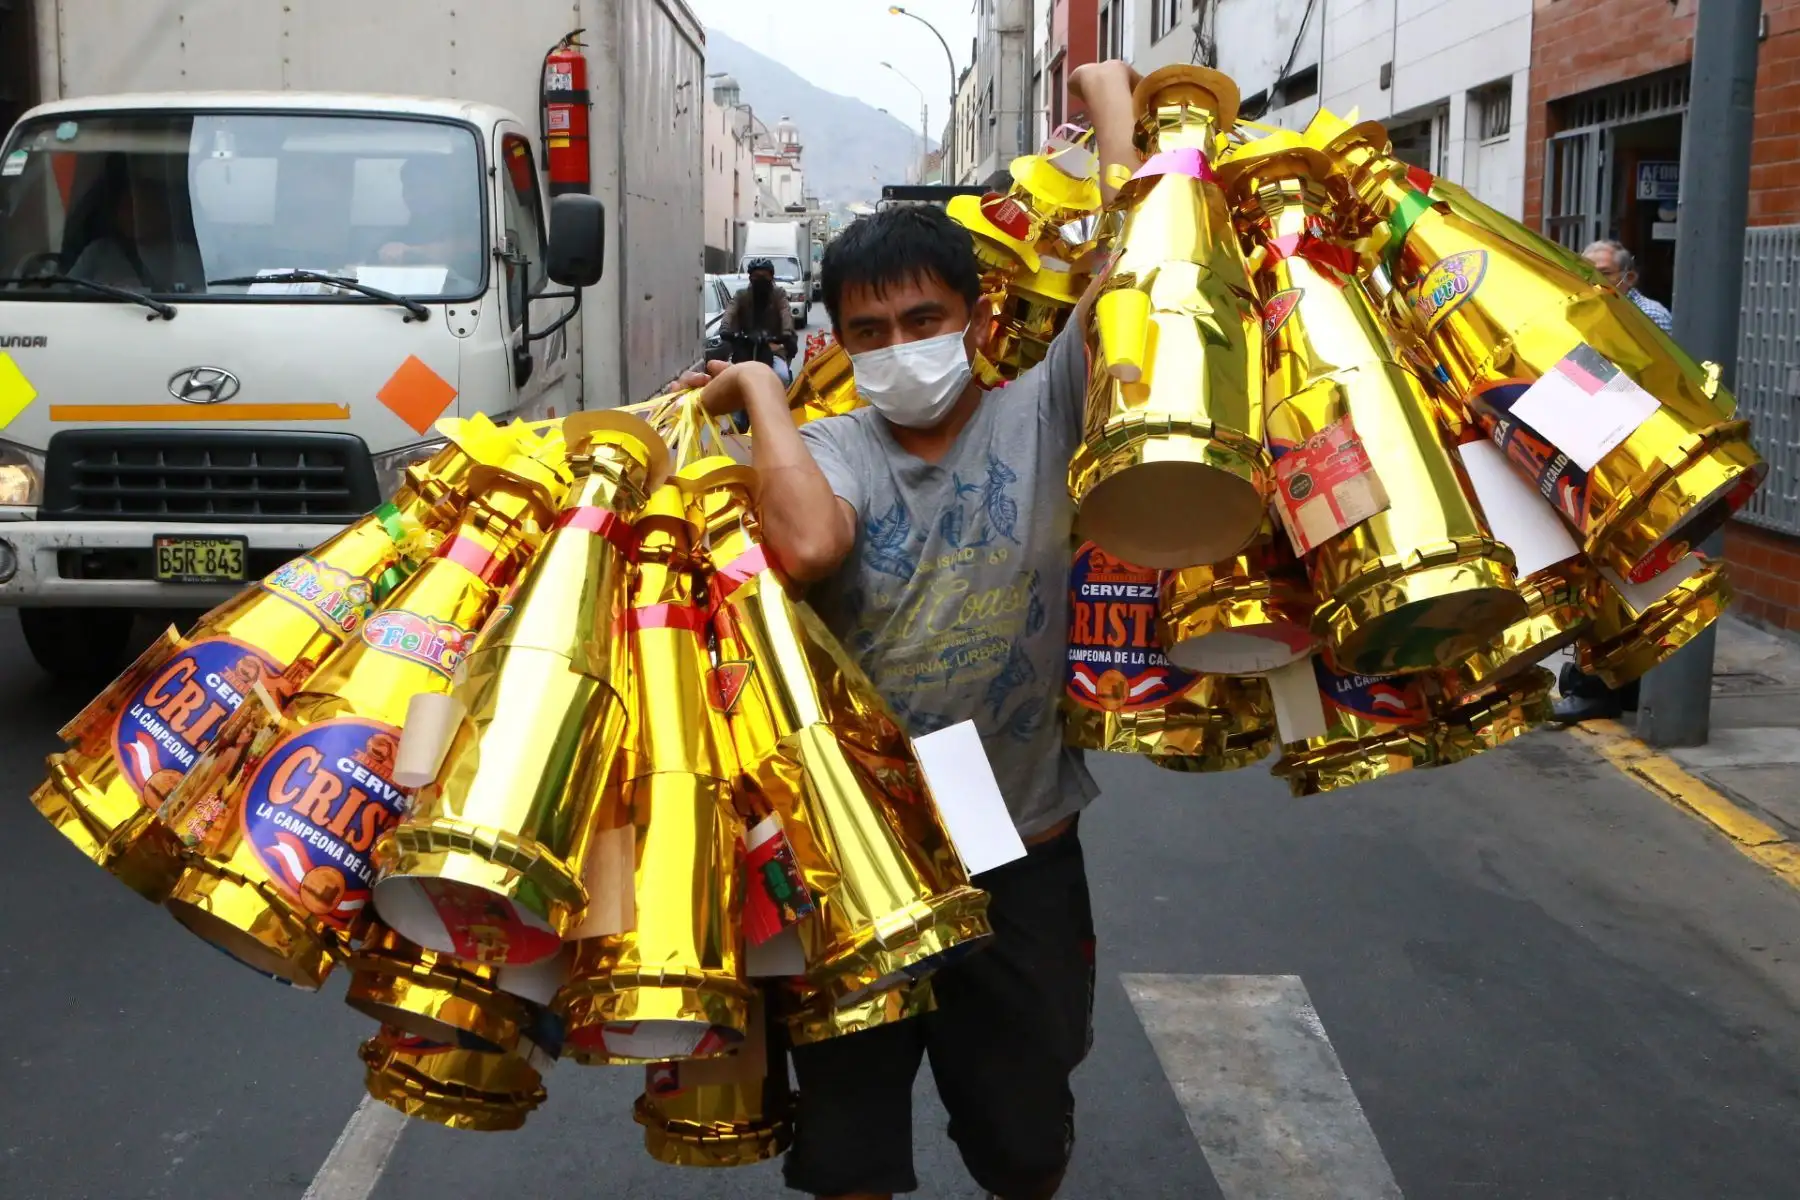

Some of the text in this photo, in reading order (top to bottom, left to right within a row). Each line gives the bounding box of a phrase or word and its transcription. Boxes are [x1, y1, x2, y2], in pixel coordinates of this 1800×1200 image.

[1641, 165, 1679, 181] AFOR
[0, 335, 48, 348] UNDAI
[160, 547, 243, 574] B5R-843
[1070, 597, 1160, 648] RIST
[1114, 652, 1128, 664] DE
[1131, 653, 1145, 665] LA
[205, 673, 245, 709] CER
[1336, 678, 1353, 692] LA
[143, 657, 228, 753] CRI
[130, 703, 195, 768] LA CAMPEONA
[268, 745, 390, 853] CRIS
[255, 802, 271, 820] LA
[273, 810, 346, 862] CAMPEONA
[343, 853, 362, 872] DE
